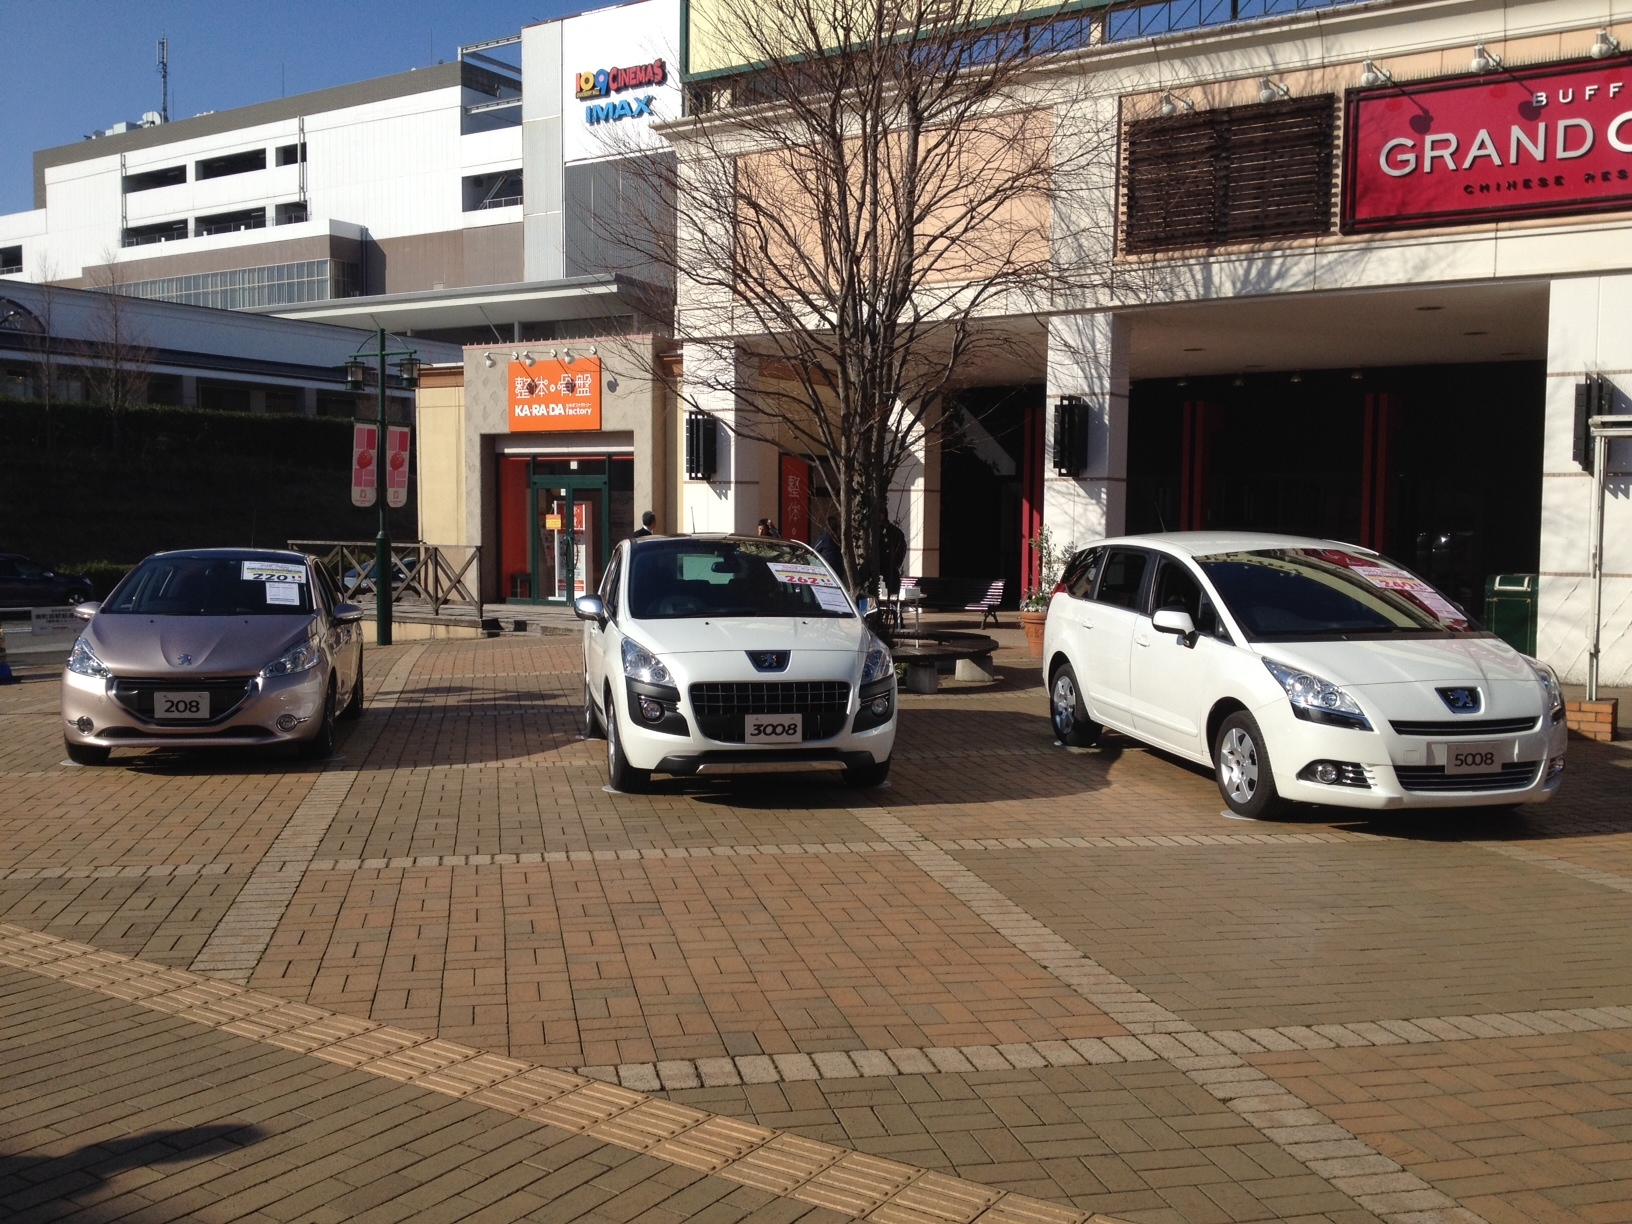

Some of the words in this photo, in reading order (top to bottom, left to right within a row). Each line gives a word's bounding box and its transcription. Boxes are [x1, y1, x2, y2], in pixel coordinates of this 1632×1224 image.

[575, 68, 609, 96] 109
[609, 58, 665, 90] CINEMAS
[1532, 82, 1623, 107] BUFF
[586, 95, 655, 124] IMAX
[1379, 117, 1594, 177] GRAND
[1463, 176, 1565, 195] CHINESE
[1584, 168, 1630, 184] RES
[565, 407, 592, 416] factory
[252, 572, 289, 582] 220
[784, 574, 820, 586] 262
[163, 699, 201, 714] 208
[749, 722, 799, 737] 3008
[1453, 751, 1495, 768] 5008
